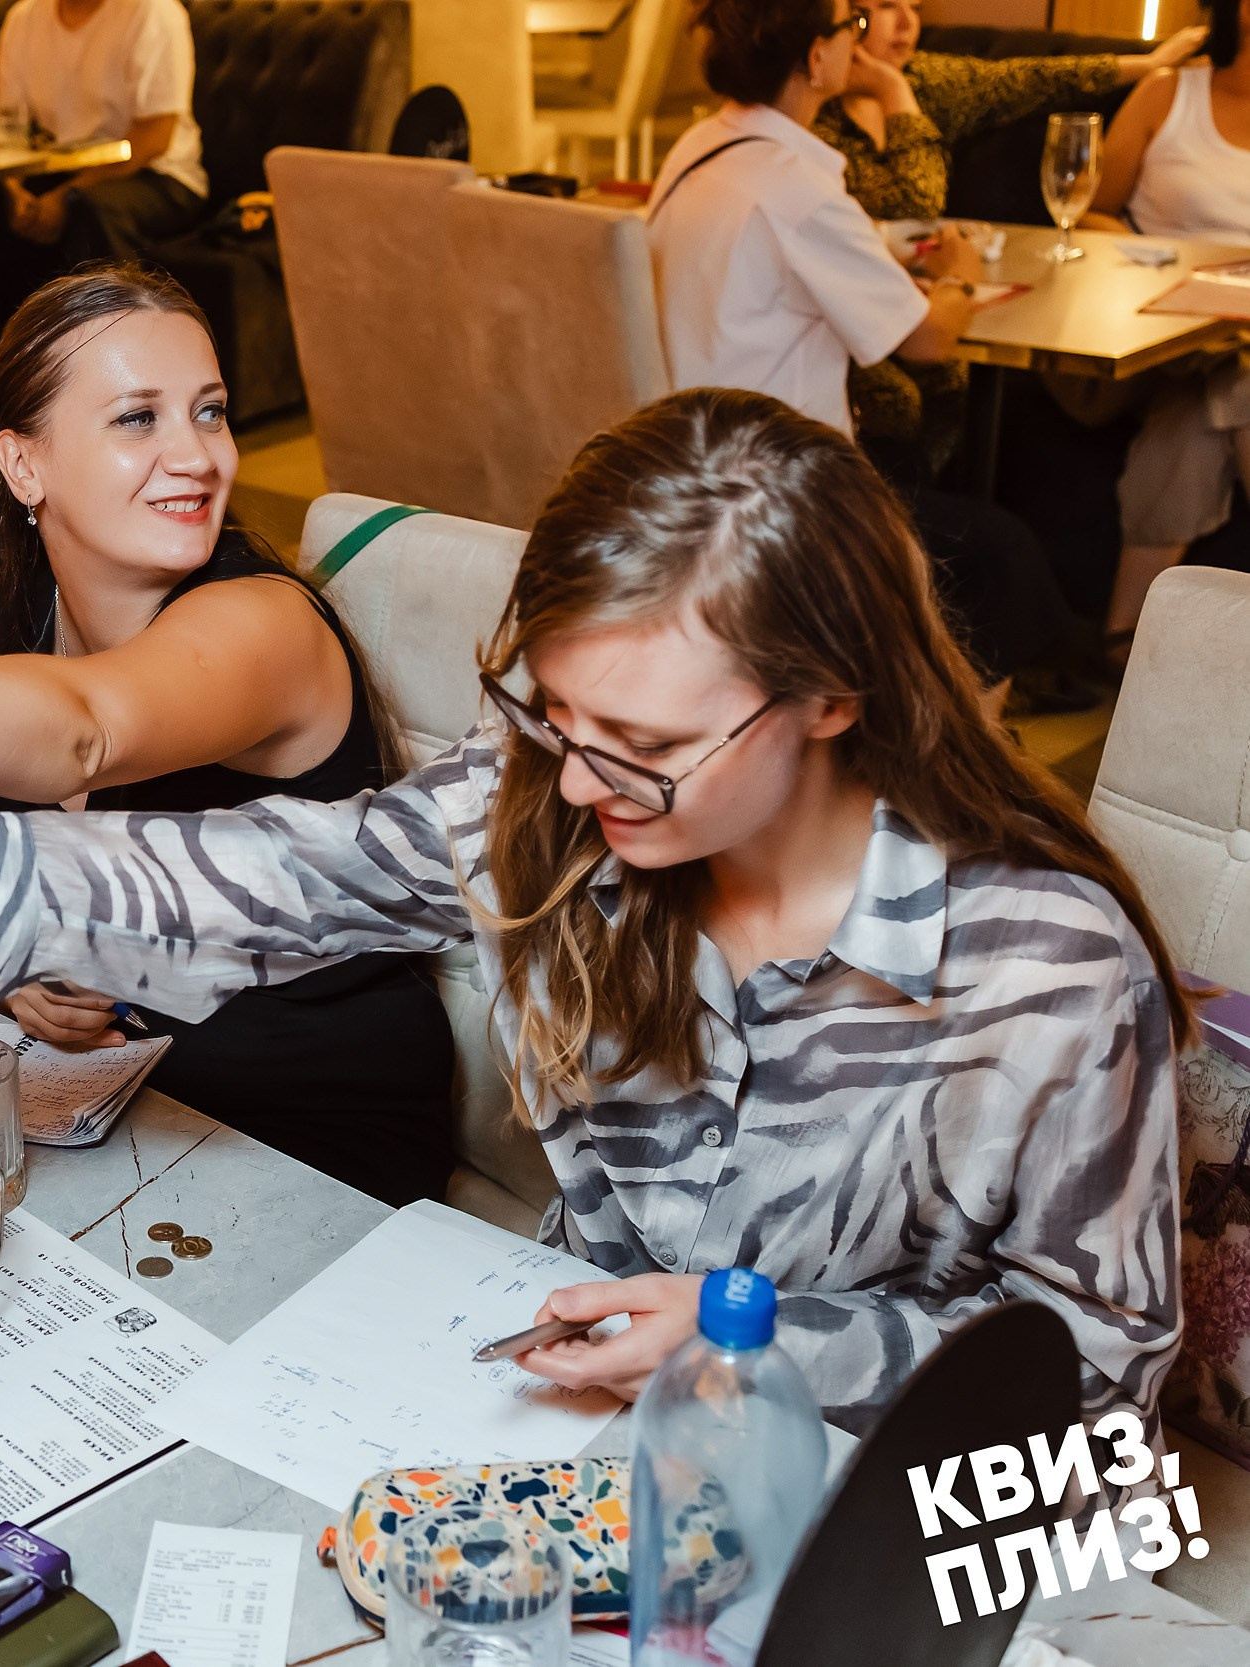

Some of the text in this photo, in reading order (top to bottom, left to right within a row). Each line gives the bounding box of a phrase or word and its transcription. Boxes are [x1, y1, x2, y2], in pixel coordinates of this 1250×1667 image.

[37, 1252, 115, 1305] ЛЕДЯНОЙ ШОТ 18
[24, 1317, 53, 1336] ДЖИН
[82, 1438, 114, 1461] ВИСКИ
